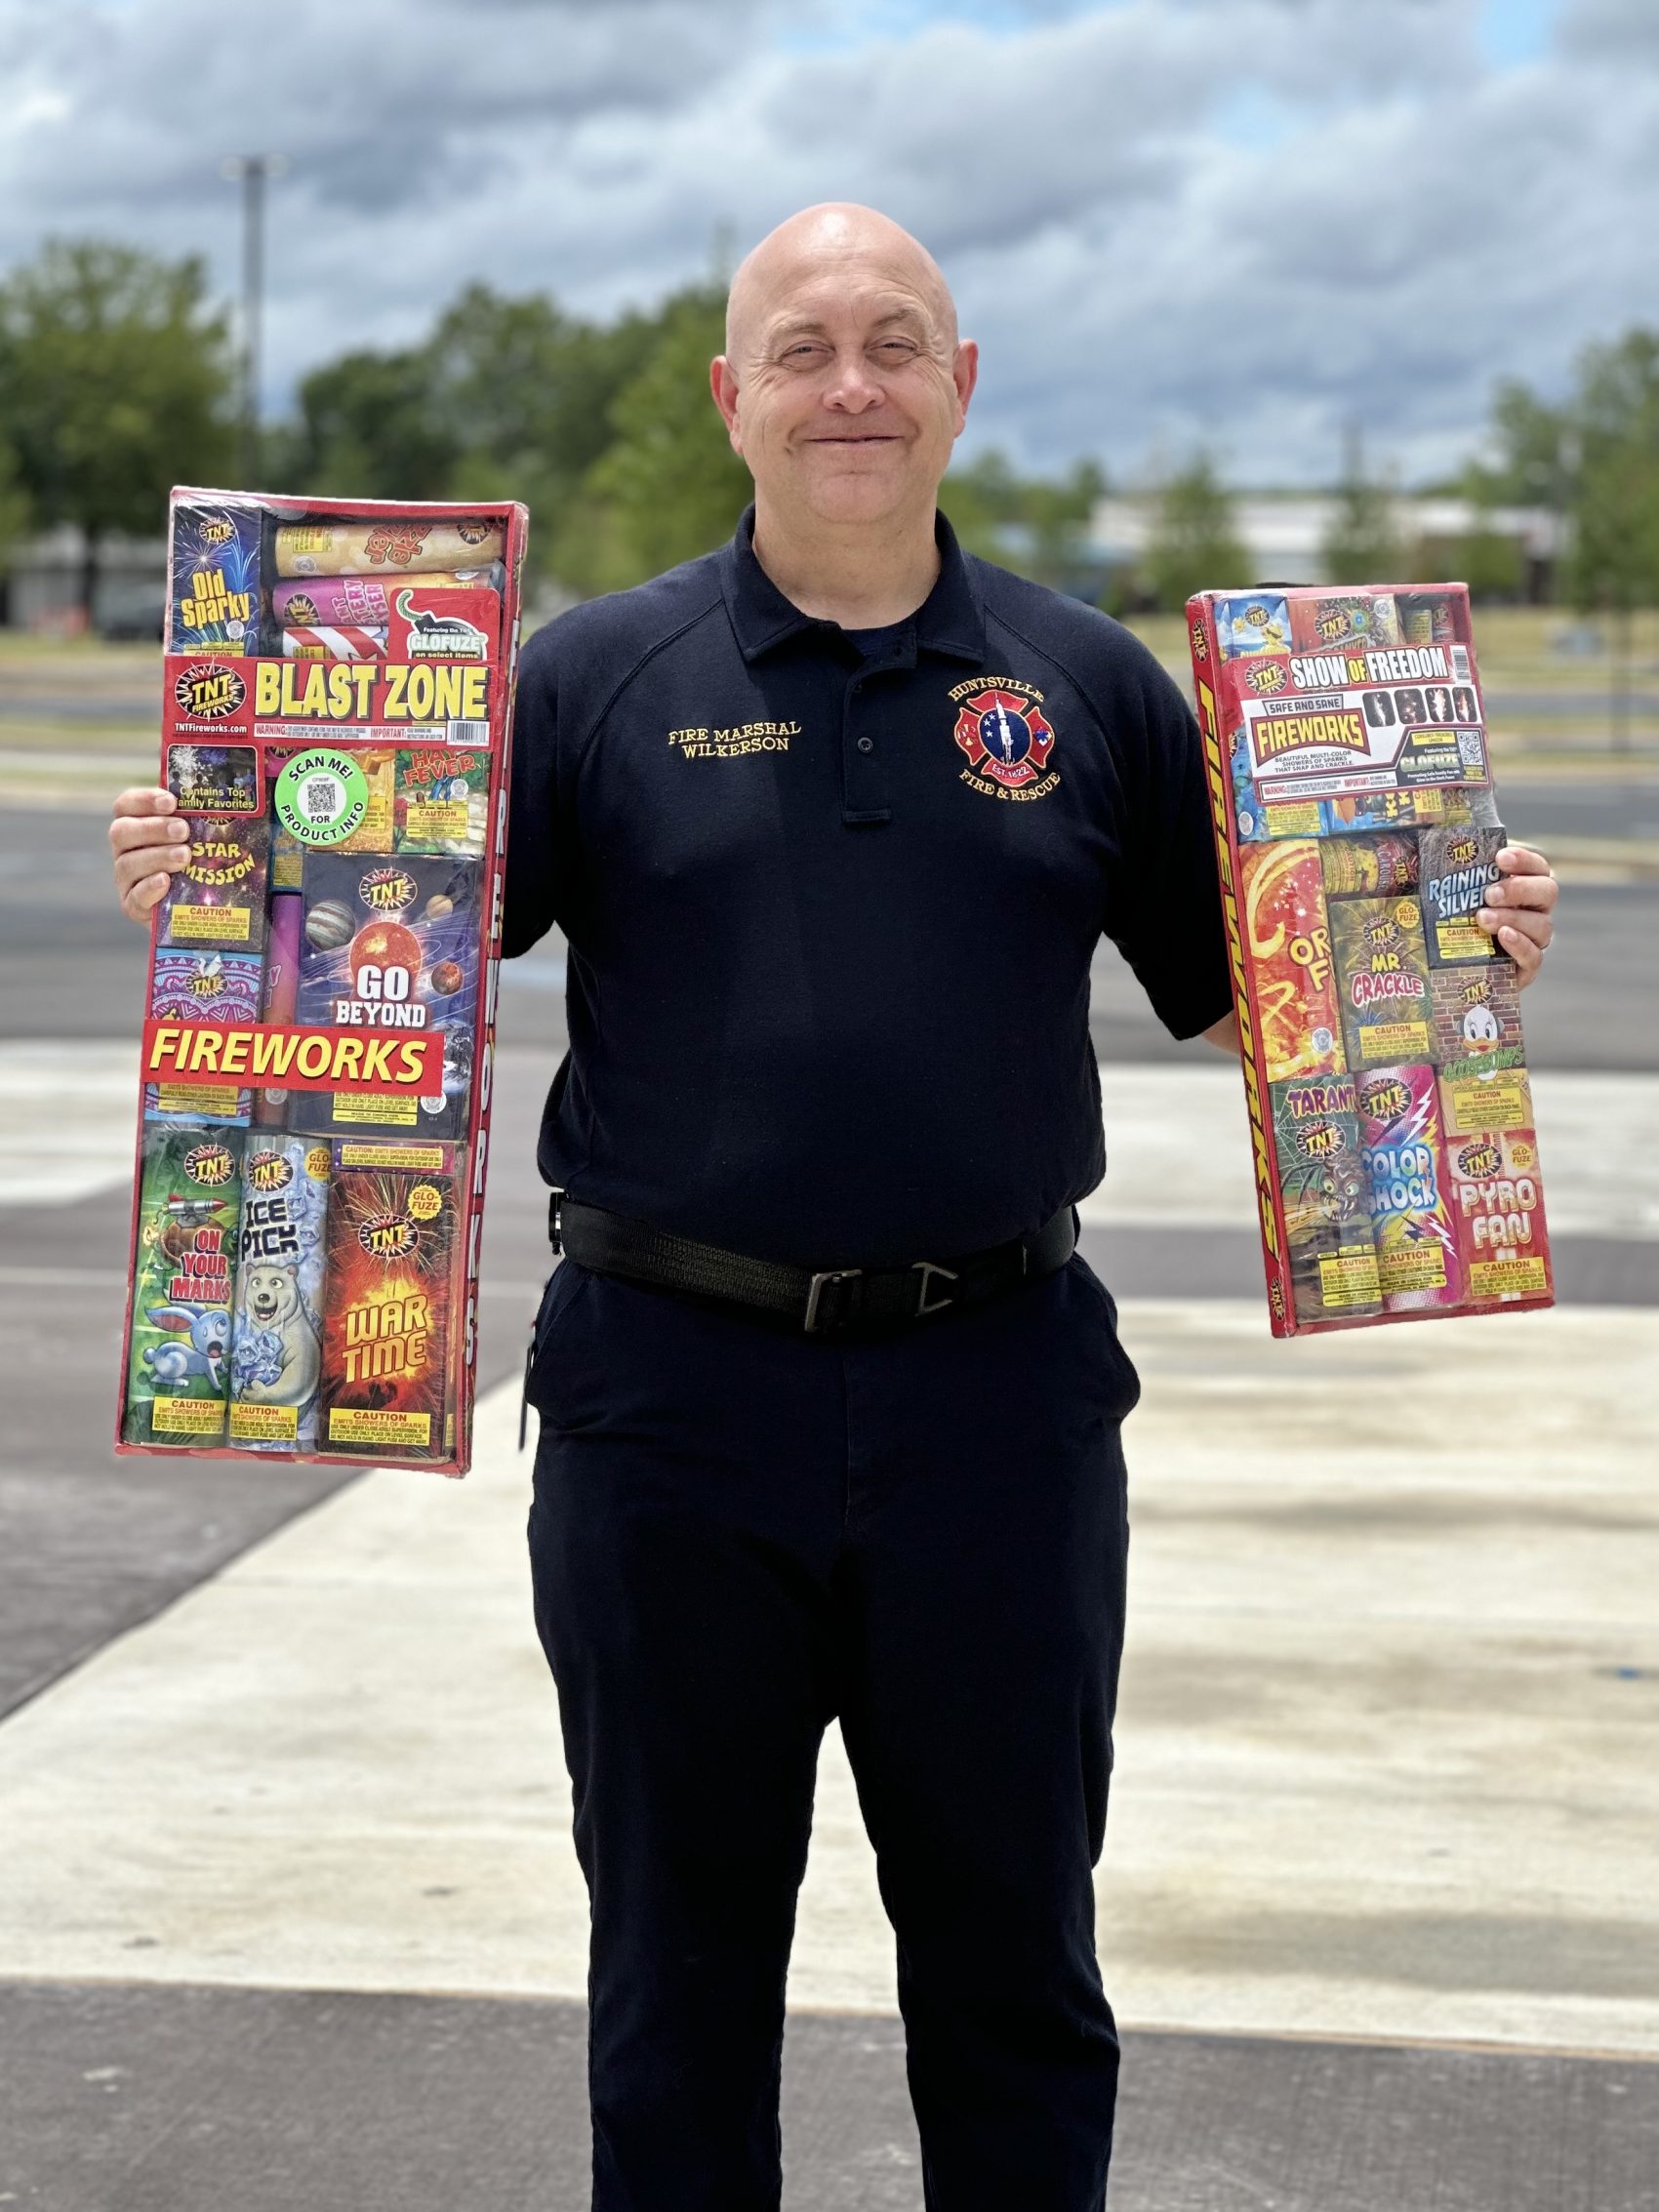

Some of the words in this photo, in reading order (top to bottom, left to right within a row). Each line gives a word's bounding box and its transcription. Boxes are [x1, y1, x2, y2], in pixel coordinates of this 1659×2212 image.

[205, 523, 229, 540] TNT
[192, 569, 225, 601] Old
[181, 591, 250, 629] Sparky
[332, 597, 352, 624] ANT
[1249, 610, 1266, 622] TNT
[1321, 616, 1344, 635] TNT
[410, 634, 481, 651] GLOFUZE
[1255, 665, 1279, 685] TNT
[1290, 656, 1350, 689] SHOW
[1348, 659, 1367, 683] OF
[1366, 646, 1449, 682] FREEDOM
[192, 673, 232, 704] TNT
[254, 662, 379, 720] BLAST
[384, 664, 489, 720] ZONE
[948, 676, 1045, 703] HUNTSVILLE
[192, 694, 235, 713] FIREWORKS
[1270, 703, 1294, 713] SAFE
[1295, 702, 1315, 712] AND
[1316, 699, 1341, 710] SANE
[175, 723, 248, 734] TNTFireworks.com
[256, 725, 288, 736] WARNING:
[371, 728, 407, 740] IMPORTANT:
[668, 729, 709, 745] FIRE
[713, 721, 802, 743] MARSHAL
[1257, 714, 1364, 758] FIREWORKS
[411, 749, 460, 768] HAY
[682, 737, 790, 759] WILKERSON
[1275, 754, 1309, 763] BEAUTIFUL
[1310, 750, 1353, 759] MULTI-COLOR
[289, 756, 325, 782] SCAN
[328, 757, 353, 780] ME!
[403, 754, 477, 787] FEVER
[992, 764, 1007, 777] EST.
[1008, 766, 1031, 779] 1822
[1282, 759, 1310, 768] SHOWERS
[180, 786, 224, 798] Contains
[227, 787, 246, 798] Top
[959, 769, 995, 795] FIRE
[997, 787, 1009, 800] &
[1010, 772, 1062, 801] RESCUE
[179, 797, 205, 809] amily
[207, 798, 255, 810] Favorites
[280, 804, 338, 842] PRODUCT
[342, 802, 364, 834] INFO
[310, 815, 331, 824] FOR
[191, 842, 242, 859] STAR
[1453, 841, 1473, 860] TNT
[181, 854, 256, 886] MISSION
[1395, 861, 1410, 883] TNT
[371, 877, 405, 904] TNT
[1430, 862, 1500, 901] RAINING
[190, 907, 232, 917] CAUTION
[1370, 922, 1393, 945] TNT
[1447, 928, 1479, 937] CAUTION
[1372, 952, 1408, 974] MR.
[193, 977, 220, 992] TNT
[357, 965, 410, 1001] GO
[1352, 973, 1425, 1008] CRACKLE
[1465, 982, 1485, 1000] TNT
[336, 1000, 427, 1027] BEYOND
[1375, 1025, 1412, 1035] CAUTION
[149, 1027, 428, 1084] FIREWORKS
[1443, 1045, 1524, 1083] GOOSEBUMPS
[1286, 1084, 1357, 1119] TARANT
[1368, 1086, 1401, 1112] TNT
[1474, 1091, 1501, 1100] CAUTION
[1307, 1127, 1335, 1154] TNT
[196, 1153, 227, 1175] TNT
[254, 1157, 280, 1181] TNT
[307, 1163, 332, 1172] FUZE
[1362, 1149, 1431, 1180] COLOR
[1467, 1153, 1495, 1174] TNT
[411, 1201, 438, 1211] FUZE
[413, 1191, 439, 1201] GLO-
[1369, 1178, 1436, 1215] SHOCK
[1459, 1178, 1538, 1218] PYRO
[245, 1197, 289, 1225] ICE
[194, 1228, 222, 1255] ON
[370, 1223, 408, 1250] TNT
[1473, 1213, 1533, 1250] FAN
[241, 1224, 300, 1263] PICK
[182, 1253, 228, 1281] YOUR
[1337, 1258, 1371, 1267] CAUTION
[1383, 1250, 1431, 1264] CAUTION
[1483, 1261, 1530, 1272] CAUTION
[170, 1277, 232, 1305] MARKS
[345, 1294, 429, 1347] WAR
[343, 1331, 428, 1384] TIME
[172, 1400, 215, 1410] CAUTION
[239, 1406, 279, 1416] CAUTION
[353, 1412, 407, 1422] CAUTION
